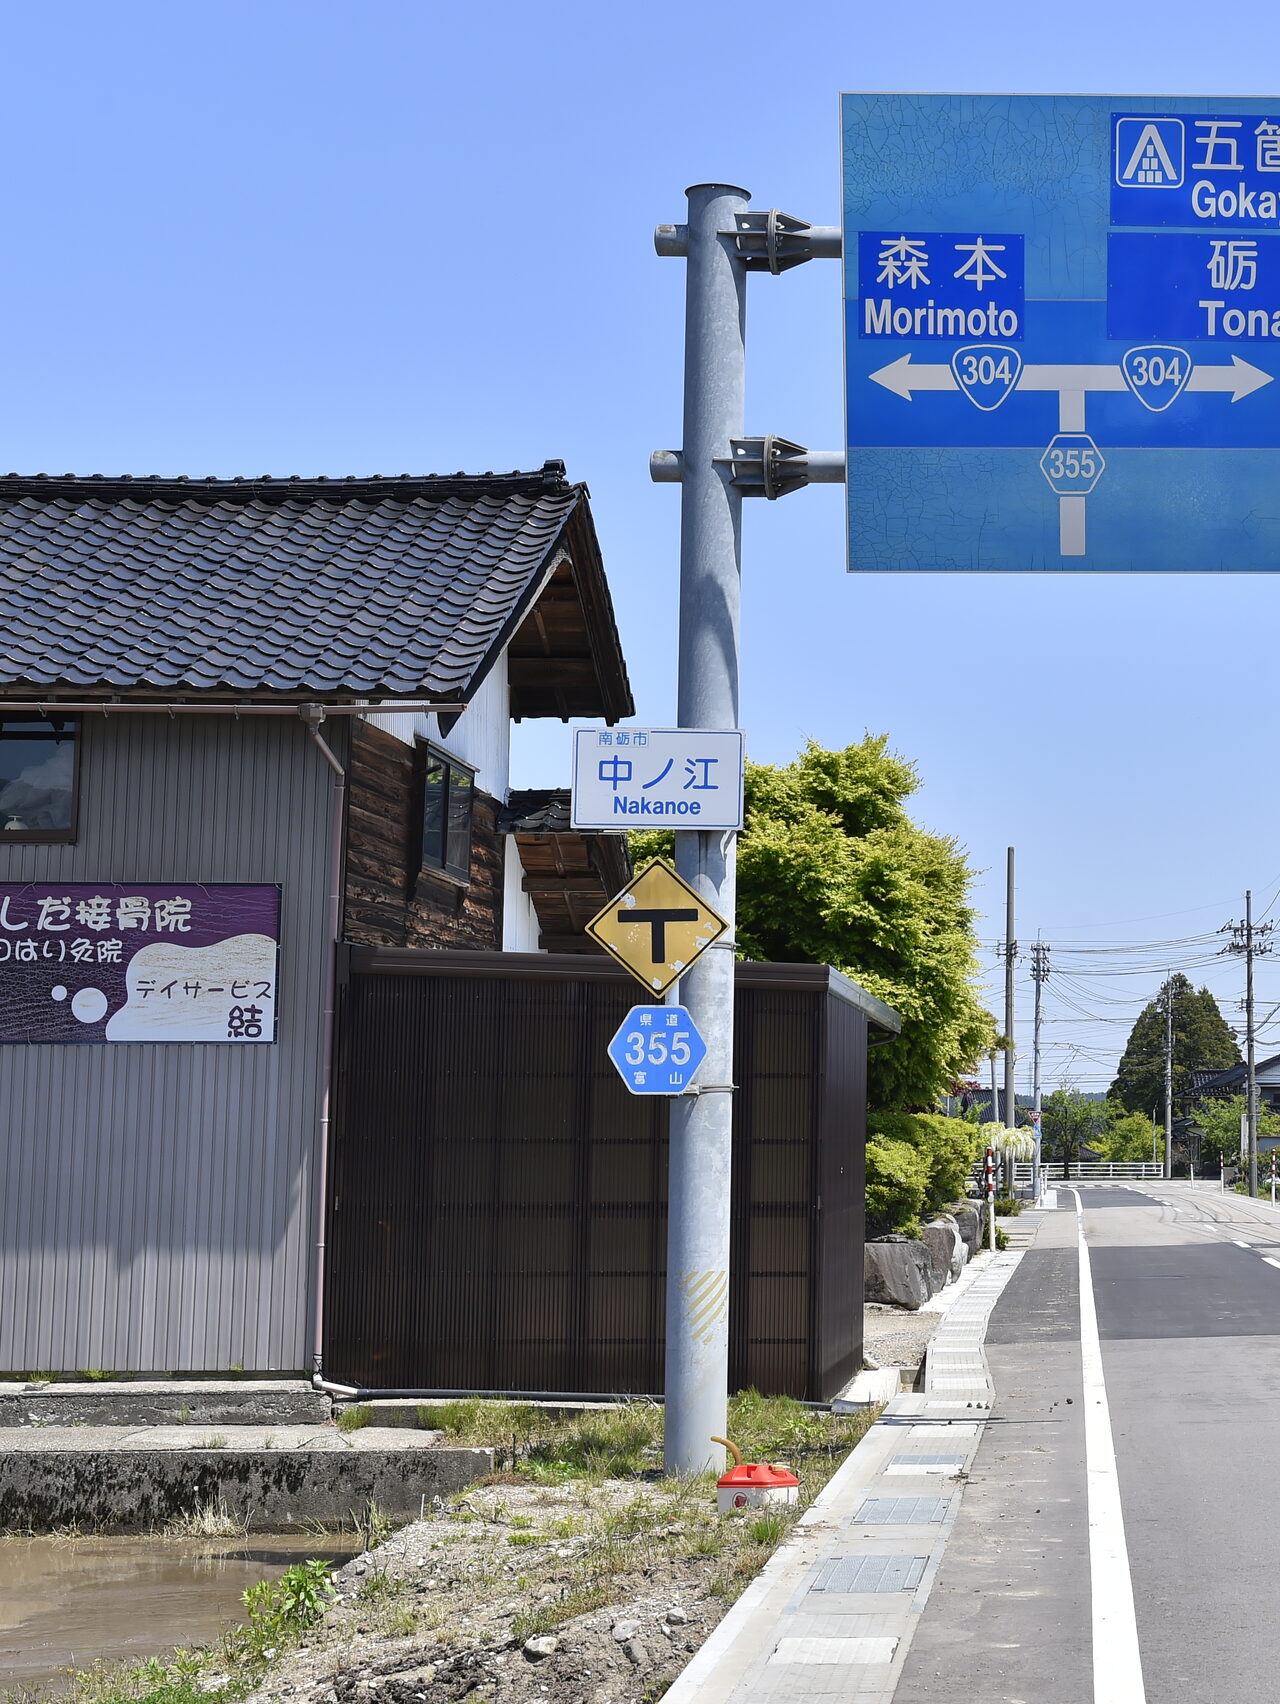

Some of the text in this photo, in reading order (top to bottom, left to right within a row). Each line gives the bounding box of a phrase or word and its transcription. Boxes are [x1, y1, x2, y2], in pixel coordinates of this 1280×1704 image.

[876, 235, 1007, 291] 森本
[865, 298, 1018, 336] Morimoto
[962, 355, 1012, 385] 304
[1132, 356, 1182, 386] 304
[1050, 449, 1096, 479] 355
[598, 731, 648, 746] 南砺市
[598, 754, 719, 791] 中ノ江
[613, 796, 701, 815] Nakanoe
[0, 895, 192, 932] しだ接骨院
[136, 980, 272, 999] デイサービス
[228, 1004, 263, 1038] 結
[639, 1013, 678, 1026] 県道
[625, 1032, 691, 1065] 355
[633, 1071, 683, 1085] 富山
